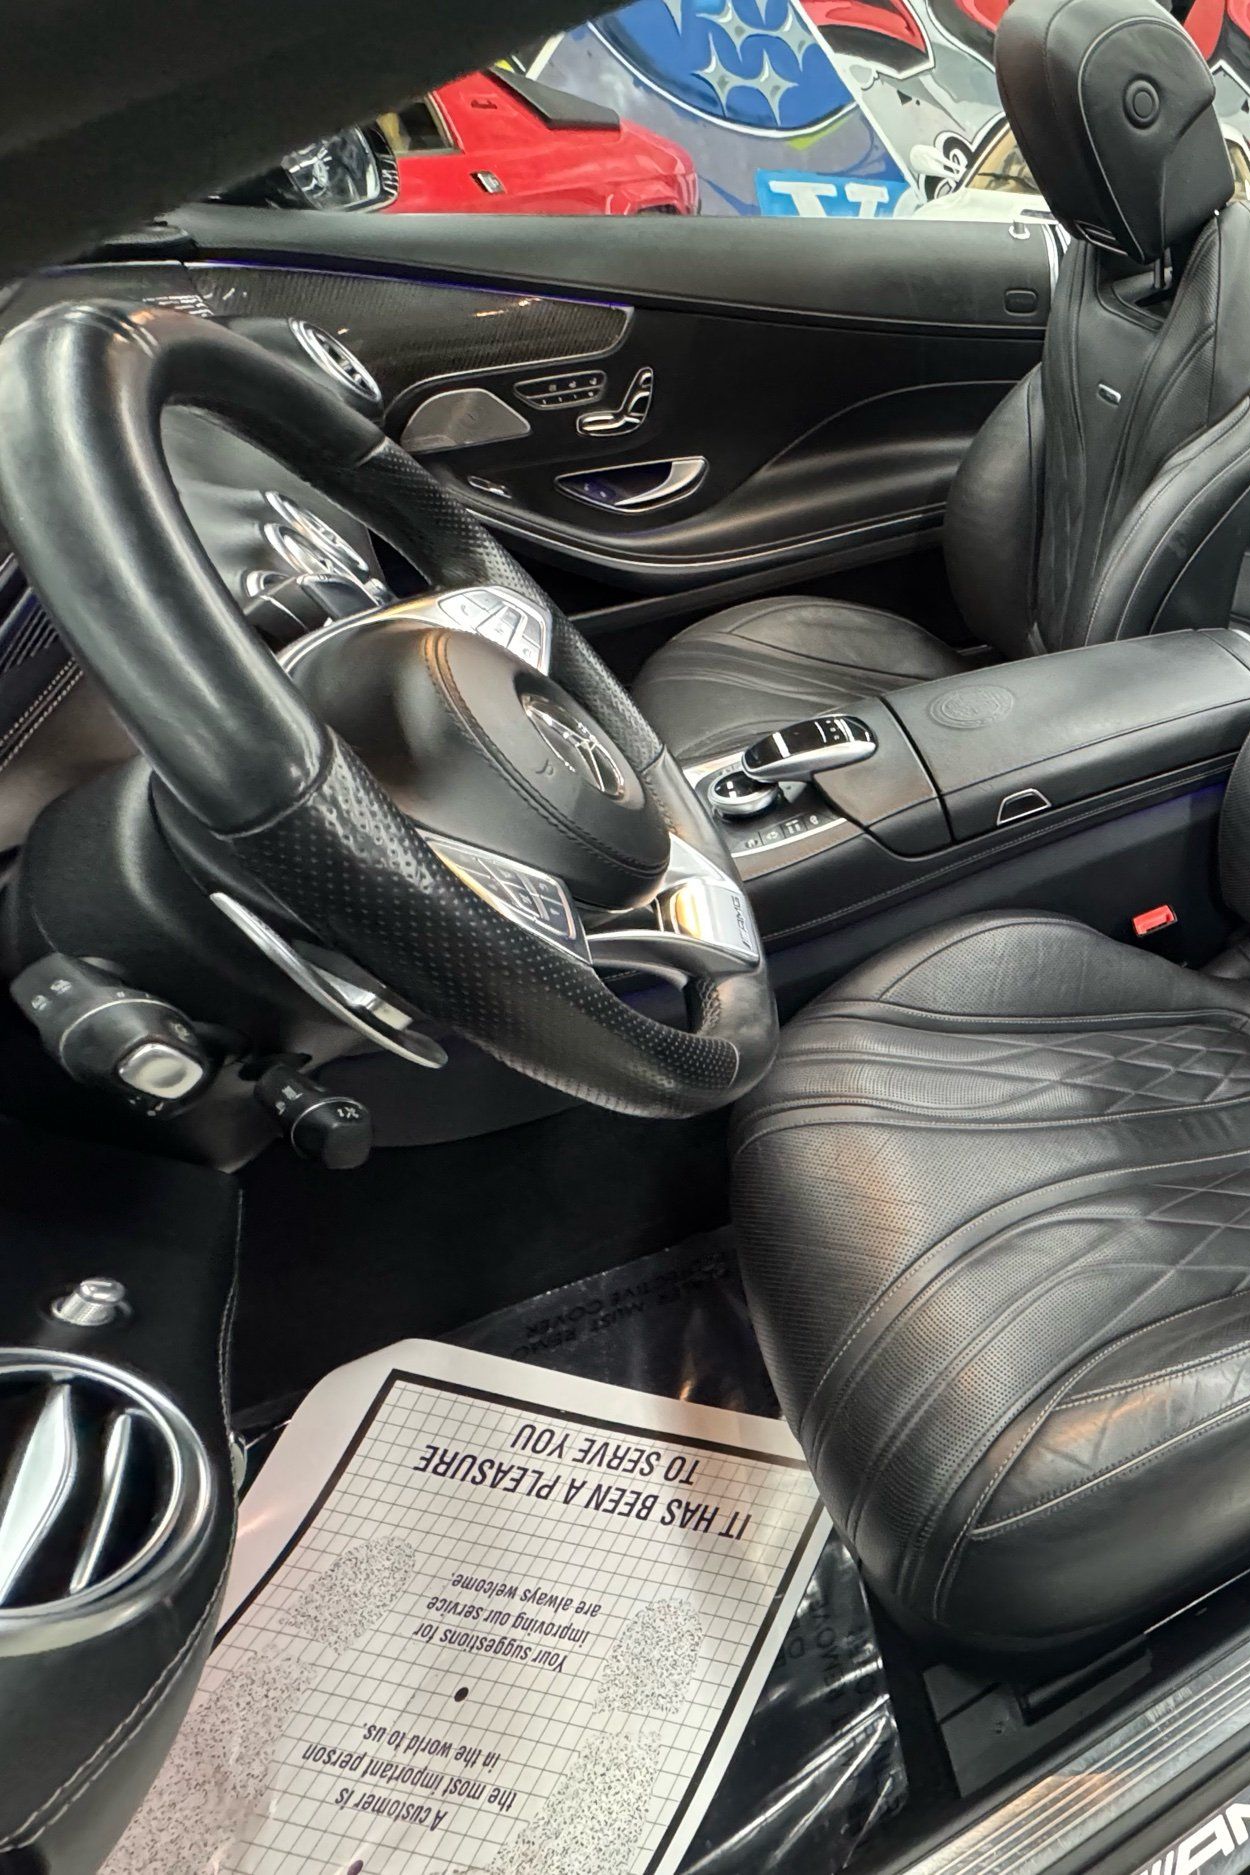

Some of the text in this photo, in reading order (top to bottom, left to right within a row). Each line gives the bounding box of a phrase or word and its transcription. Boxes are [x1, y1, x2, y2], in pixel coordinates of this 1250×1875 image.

[510, 1423, 700, 1485] TO SERVE YOU
[413, 1444, 752, 1541] IT HAS BEEN A PLEASURE
[450, 1573, 602, 1618] are always welcome.
[426, 1596, 590, 1648] improving our service
[412, 1623, 568, 1673] Your suggestions for
[363, 1723, 500, 1773] in the world to us.
[302, 1744, 517, 1812] the most important person
[335, 1788, 448, 1832] A customer is
